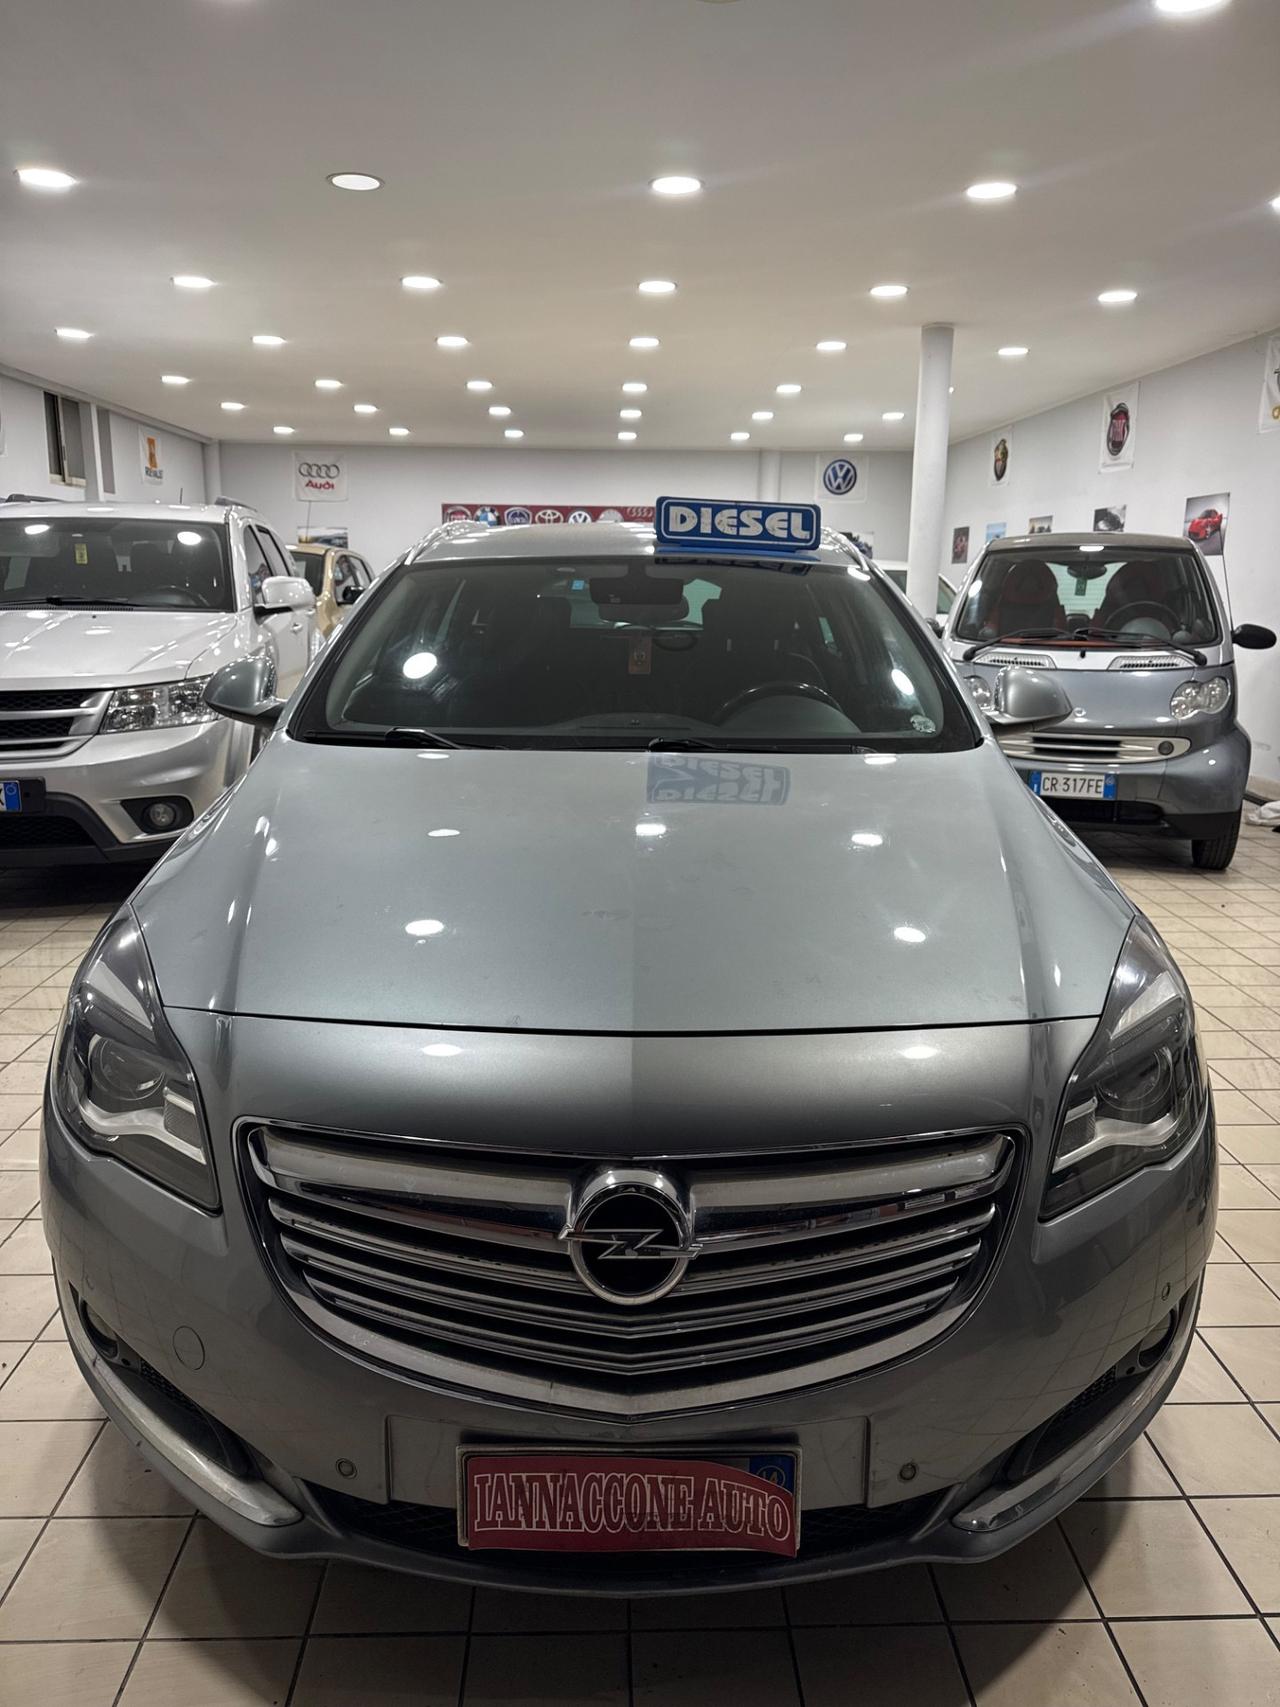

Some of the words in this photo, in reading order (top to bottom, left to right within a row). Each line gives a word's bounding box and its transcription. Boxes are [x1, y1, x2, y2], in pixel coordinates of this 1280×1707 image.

[305, 479, 335, 490] Audi
[668, 506, 811, 540] DIESEL
[1042, 776, 1059, 793] CR
[1062, 777, 1104, 794] 317FE
[473, 1472, 695, 1534] IANNACCONE
[697, 1478, 791, 1541] AUTO
